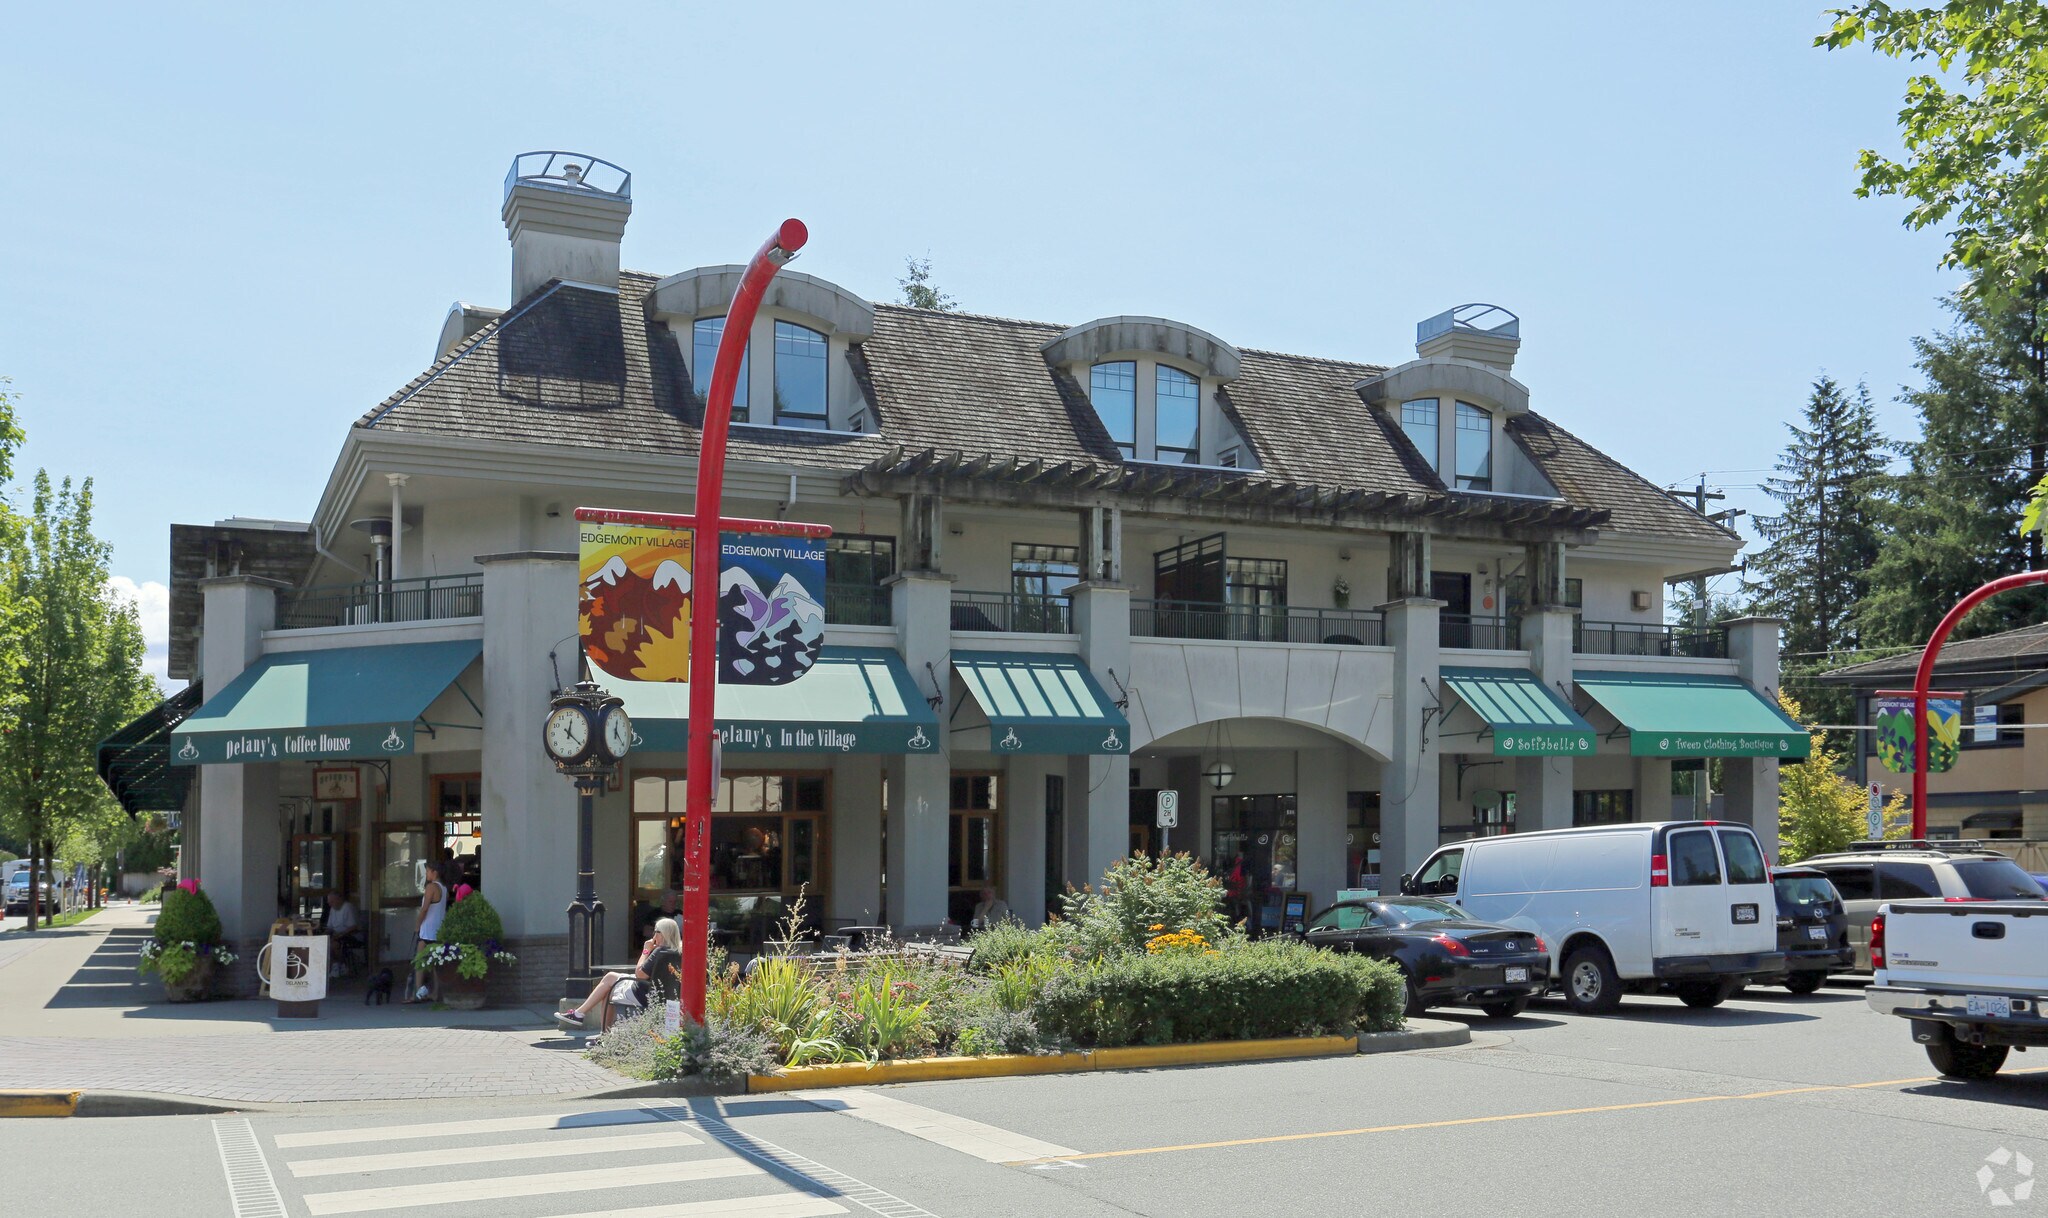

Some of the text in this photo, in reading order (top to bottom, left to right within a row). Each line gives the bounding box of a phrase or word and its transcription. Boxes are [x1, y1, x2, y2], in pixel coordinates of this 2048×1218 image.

[580, 532, 691, 549] EDGEMONT VILLAGE
[722, 544, 825, 561] EDGEMONT VILLAGE
[226, 734, 351, 760] Delany's Coffee House
[781, 728, 793, 747] In
[796, 728, 815, 747] the
[817, 729, 857, 752] Village
[1518, 736, 1575, 751] Sofiabella
[1676, 738, 1774, 751] Tween Clothing Boutique
[1165, 796, 1171, 806] P
